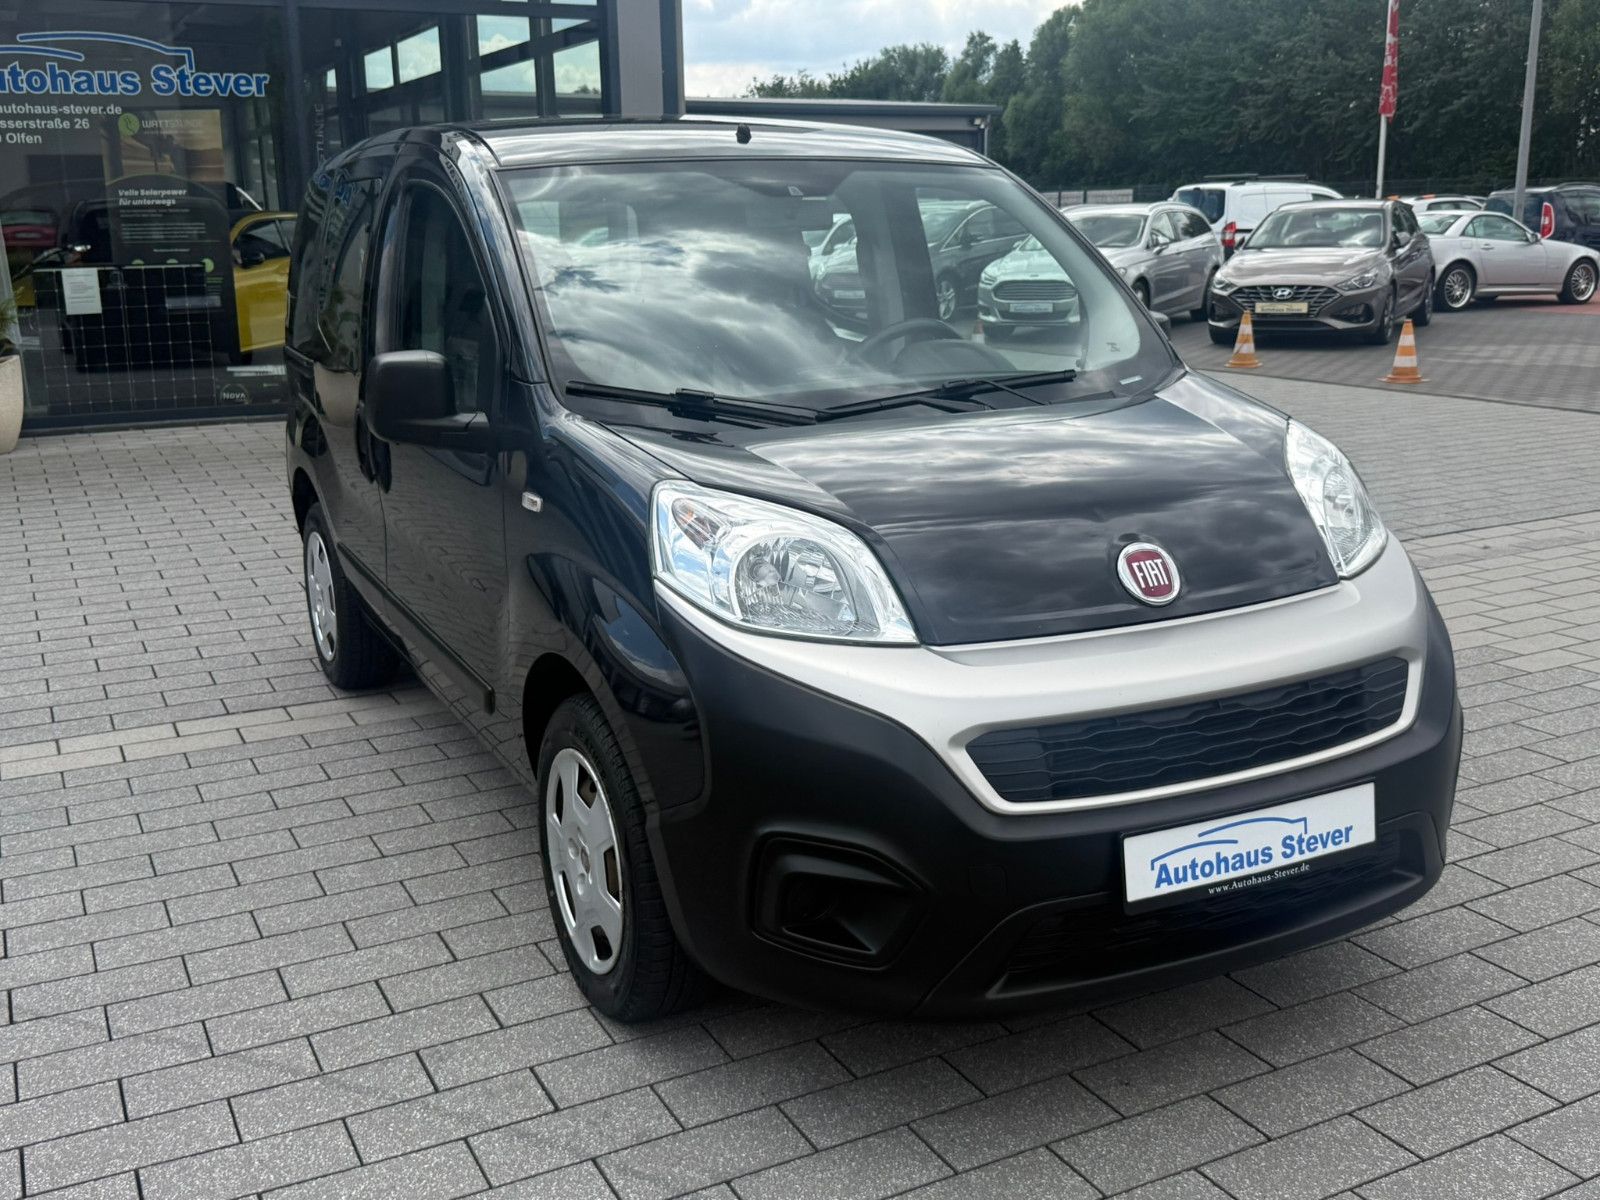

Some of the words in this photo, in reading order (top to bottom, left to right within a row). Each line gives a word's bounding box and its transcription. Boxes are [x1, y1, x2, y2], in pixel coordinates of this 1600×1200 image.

[151, 64, 270, 97] Stever
[6, 133, 42, 144] Olfen
[74, 118, 90, 129] 26
[132, 198, 176, 207] unterwegs
[1131, 558, 1169, 589] FIAT
[1155, 845, 1273, 888] Autohaus
[1281, 825, 1354, 859] Stever
[1208, 862, 1311, 894] www.Autohaus-Stever.de
